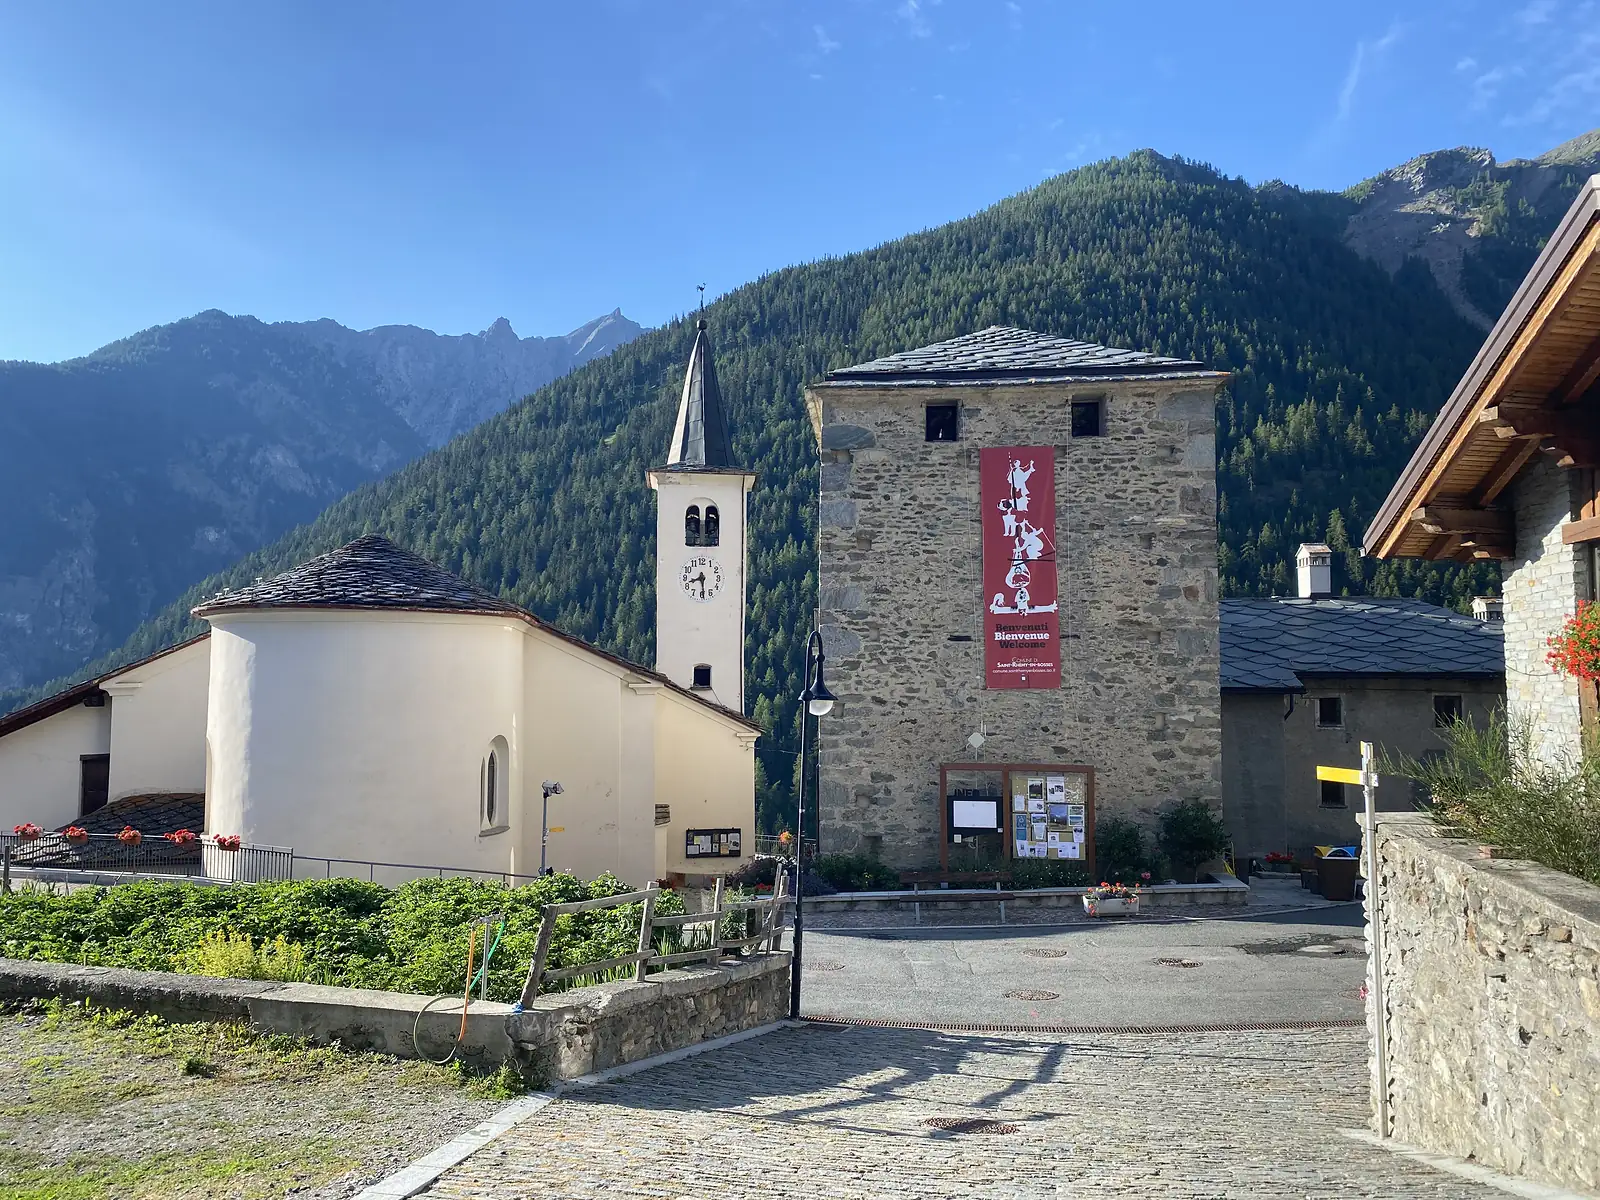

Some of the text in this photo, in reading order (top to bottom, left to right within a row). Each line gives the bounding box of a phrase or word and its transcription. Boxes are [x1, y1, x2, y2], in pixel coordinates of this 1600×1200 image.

[698, 558, 706, 566] 12
[996, 623, 1048, 632] Benvenuti
[994, 632, 1050, 640] Bienvenue
